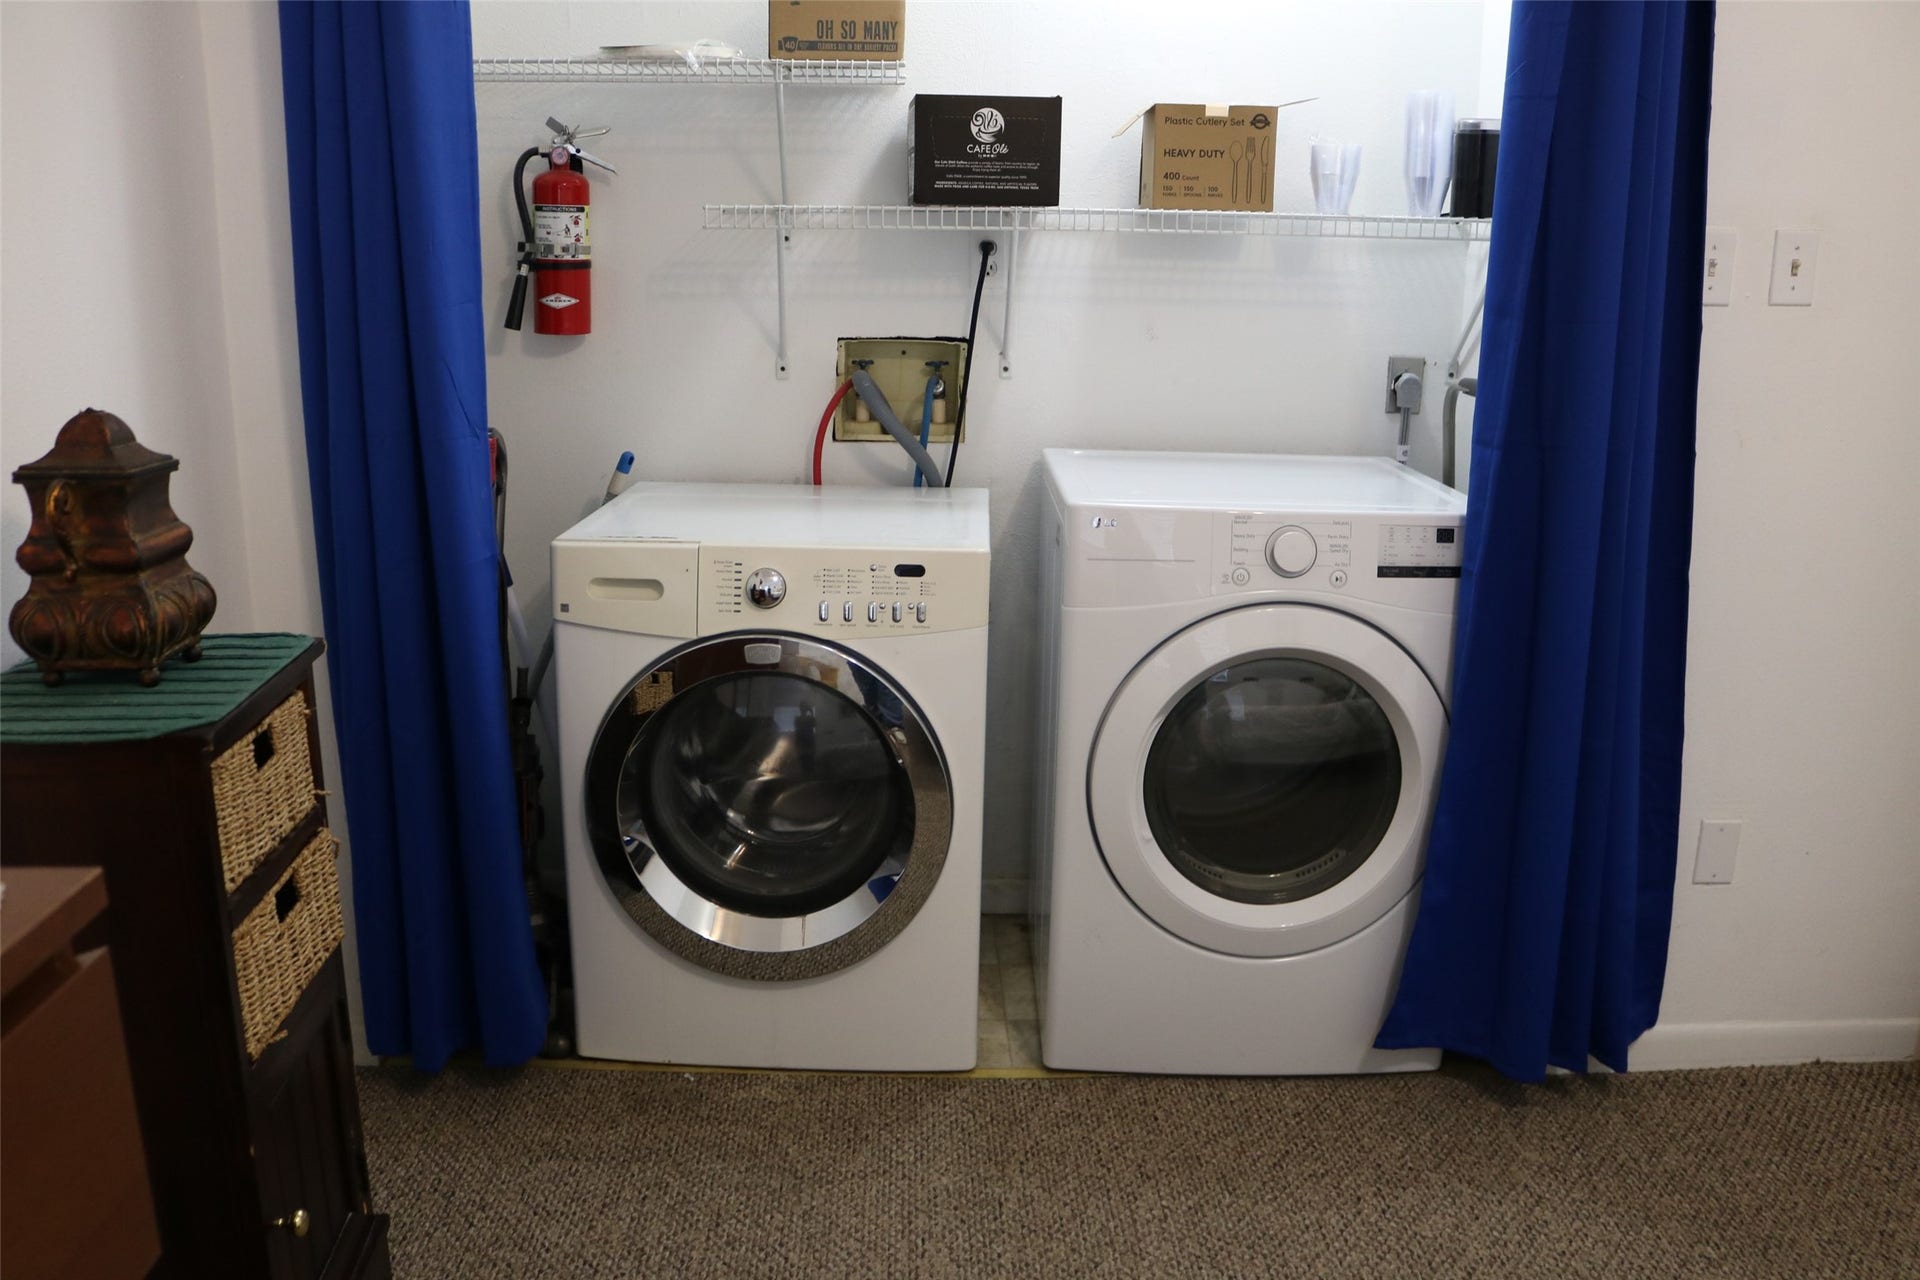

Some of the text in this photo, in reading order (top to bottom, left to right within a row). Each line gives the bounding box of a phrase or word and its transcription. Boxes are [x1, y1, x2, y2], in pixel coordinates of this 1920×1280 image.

[816, 20, 899, 41] OH SO MANY
[785, 41, 796, 50] 40
[1164, 117, 1193, 126] Plastic
[1196, 117, 1228, 128] Cutlery
[1230, 117, 1245, 126] Set
[967, 143, 1009, 155] CAFE Olé
[1163, 149, 1226, 158] HEAVY DUTY
[1163, 171, 1181, 181] 400
